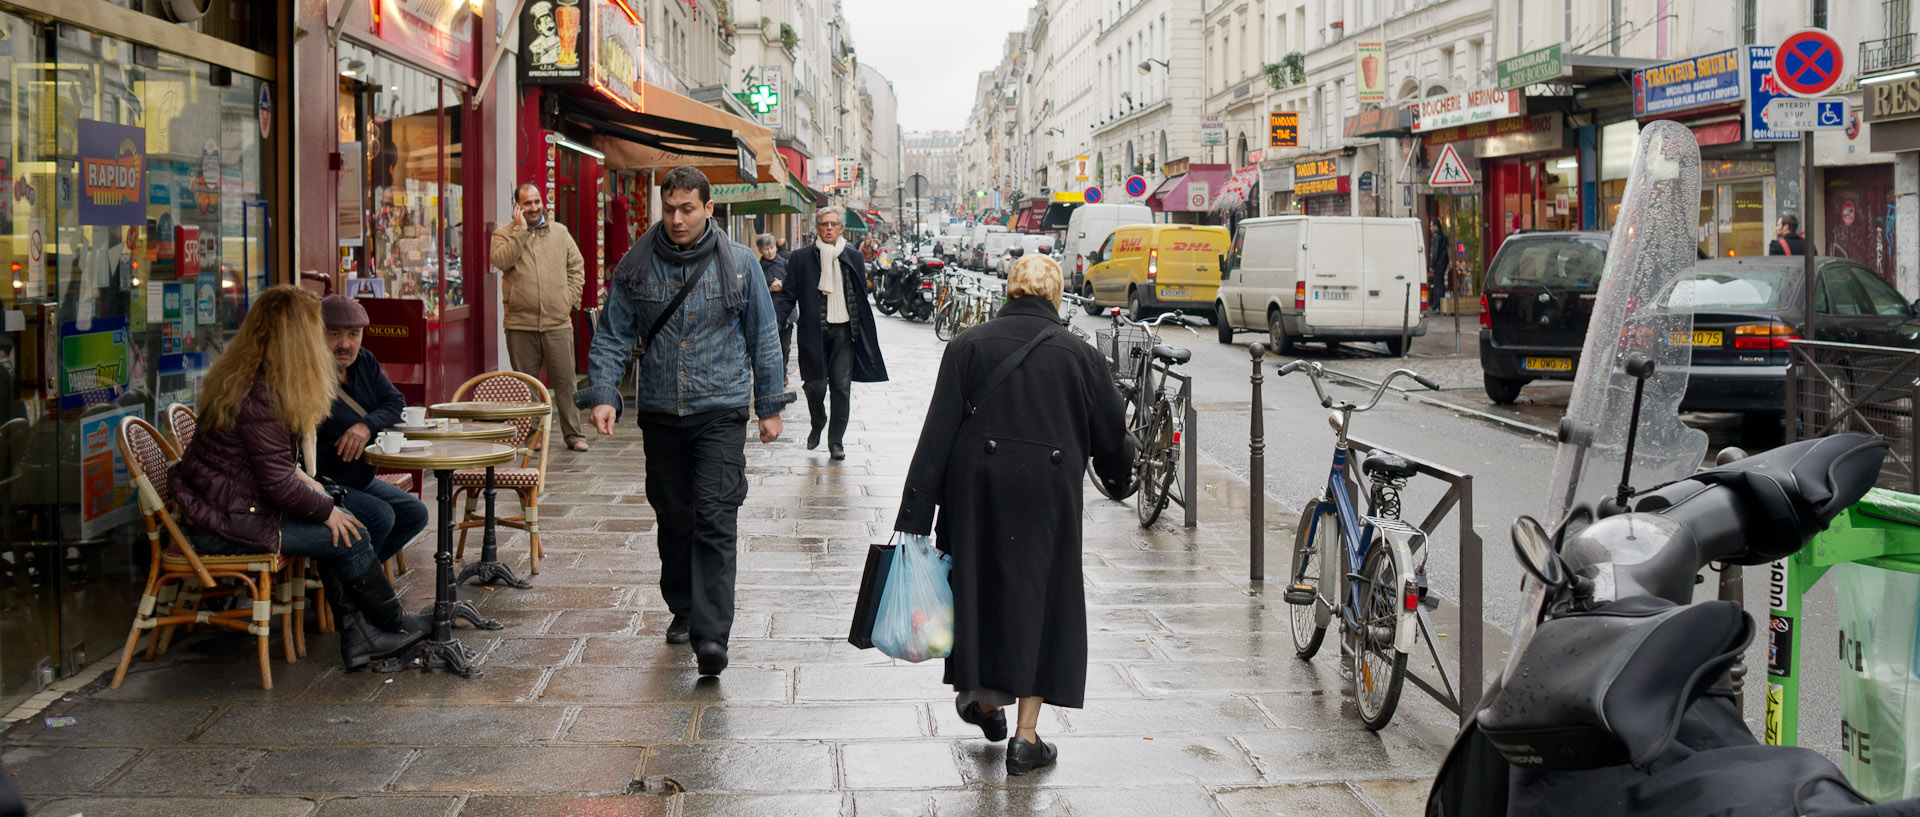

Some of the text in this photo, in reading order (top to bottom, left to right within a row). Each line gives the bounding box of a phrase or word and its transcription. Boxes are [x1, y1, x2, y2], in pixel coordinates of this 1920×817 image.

[1751, 48, 1775, 57] TRAI
[1506, 50, 1551, 73] RESTAURANT
[1752, 60, 1772, 69] ASIA
[1646, 60, 1696, 88] TRAITEUR
[1422, 95, 1462, 118] BOUCHERIE
[1468, 88, 1505, 108] MERINOS
[1276, 129, 1291, 140] TIME
[88, 163, 137, 190] RAPIDO
[184, 240, 199, 263] SFR
[1172, 242, 1213, 252] DHL
[368, 326, 407, 336] NICOLAS
[1706, 333, 1720, 344] 75
[1560, 360, 1569, 368] 75
